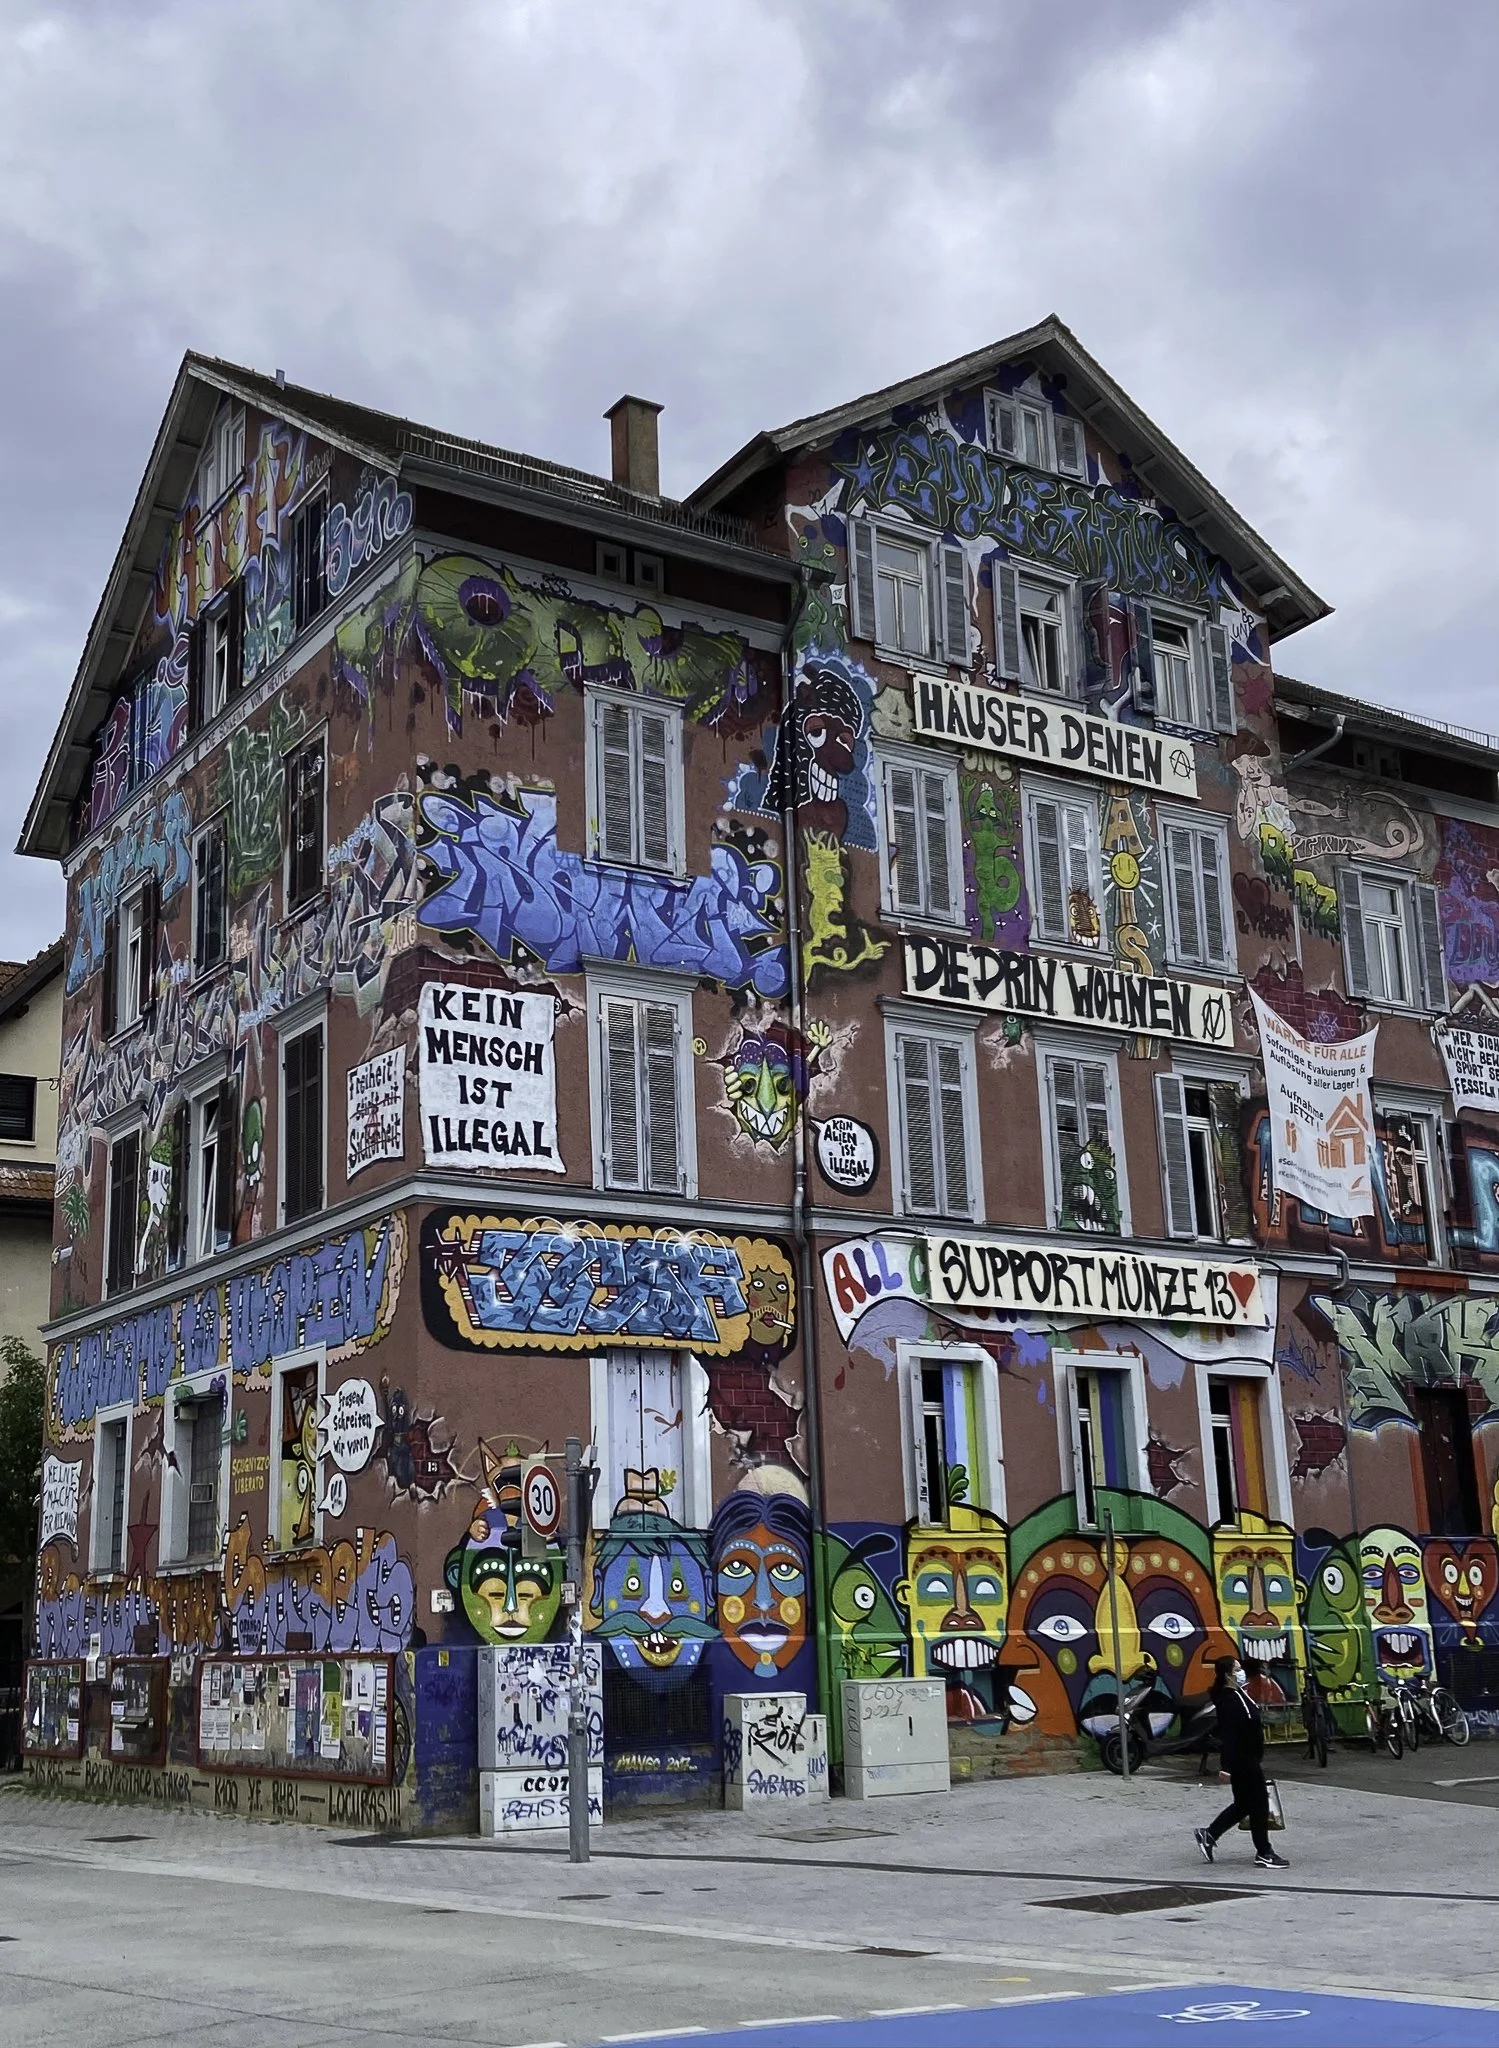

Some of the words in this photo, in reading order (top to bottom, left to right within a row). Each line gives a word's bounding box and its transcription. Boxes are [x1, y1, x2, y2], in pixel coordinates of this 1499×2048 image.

[919, 682, 1050, 758] HÄUSER
[1061, 715, 1163, 785] DENEN
[906, 934, 970, 1000] DIE
[969, 944, 1058, 1016] DRIN
[1062, 961, 1194, 1037] WOHNEN
[433, 989, 525, 1030] KEIN
[425, 1026, 544, 1075] MENSCH
[1265, 1034, 1305, 1066] Sofortige
[1307, 1060, 1356, 1078] Evakuierung
[1360, 1063, 1366, 1073] &
[1340, 1045, 1367, 1061] ALLE
[1445, 1044, 1475, 1063] NICHT
[1452, 1031, 1474, 1048] WER
[1478, 1034, 1499, 1053] SICH
[1270, 1050, 1312, 1085] Auflösung
[1313, 1078, 1331, 1090] aller
[1333, 1080, 1355, 1092] Lager
[1454, 1077, 1496, 1098] FESSELN
[458, 1075, 513, 1109] IST
[1280, 1083, 1324, 1121] Aufnahme
[1289, 1101, 1315, 1127] JETZT
[429, 1115, 552, 1158] ILLEGAL
[833, 1240, 903, 1314] ALL
[939, 1240, 1097, 1308] SUPPORT
[1100, 1251, 1206, 1317] MÜNZE
[1205, 1266, 1238, 1320] 13
[48, 1465, 78, 1484] KEINE
[47, 1485, 77, 1511] MACHT
[532, 1484, 553, 1516] 30
